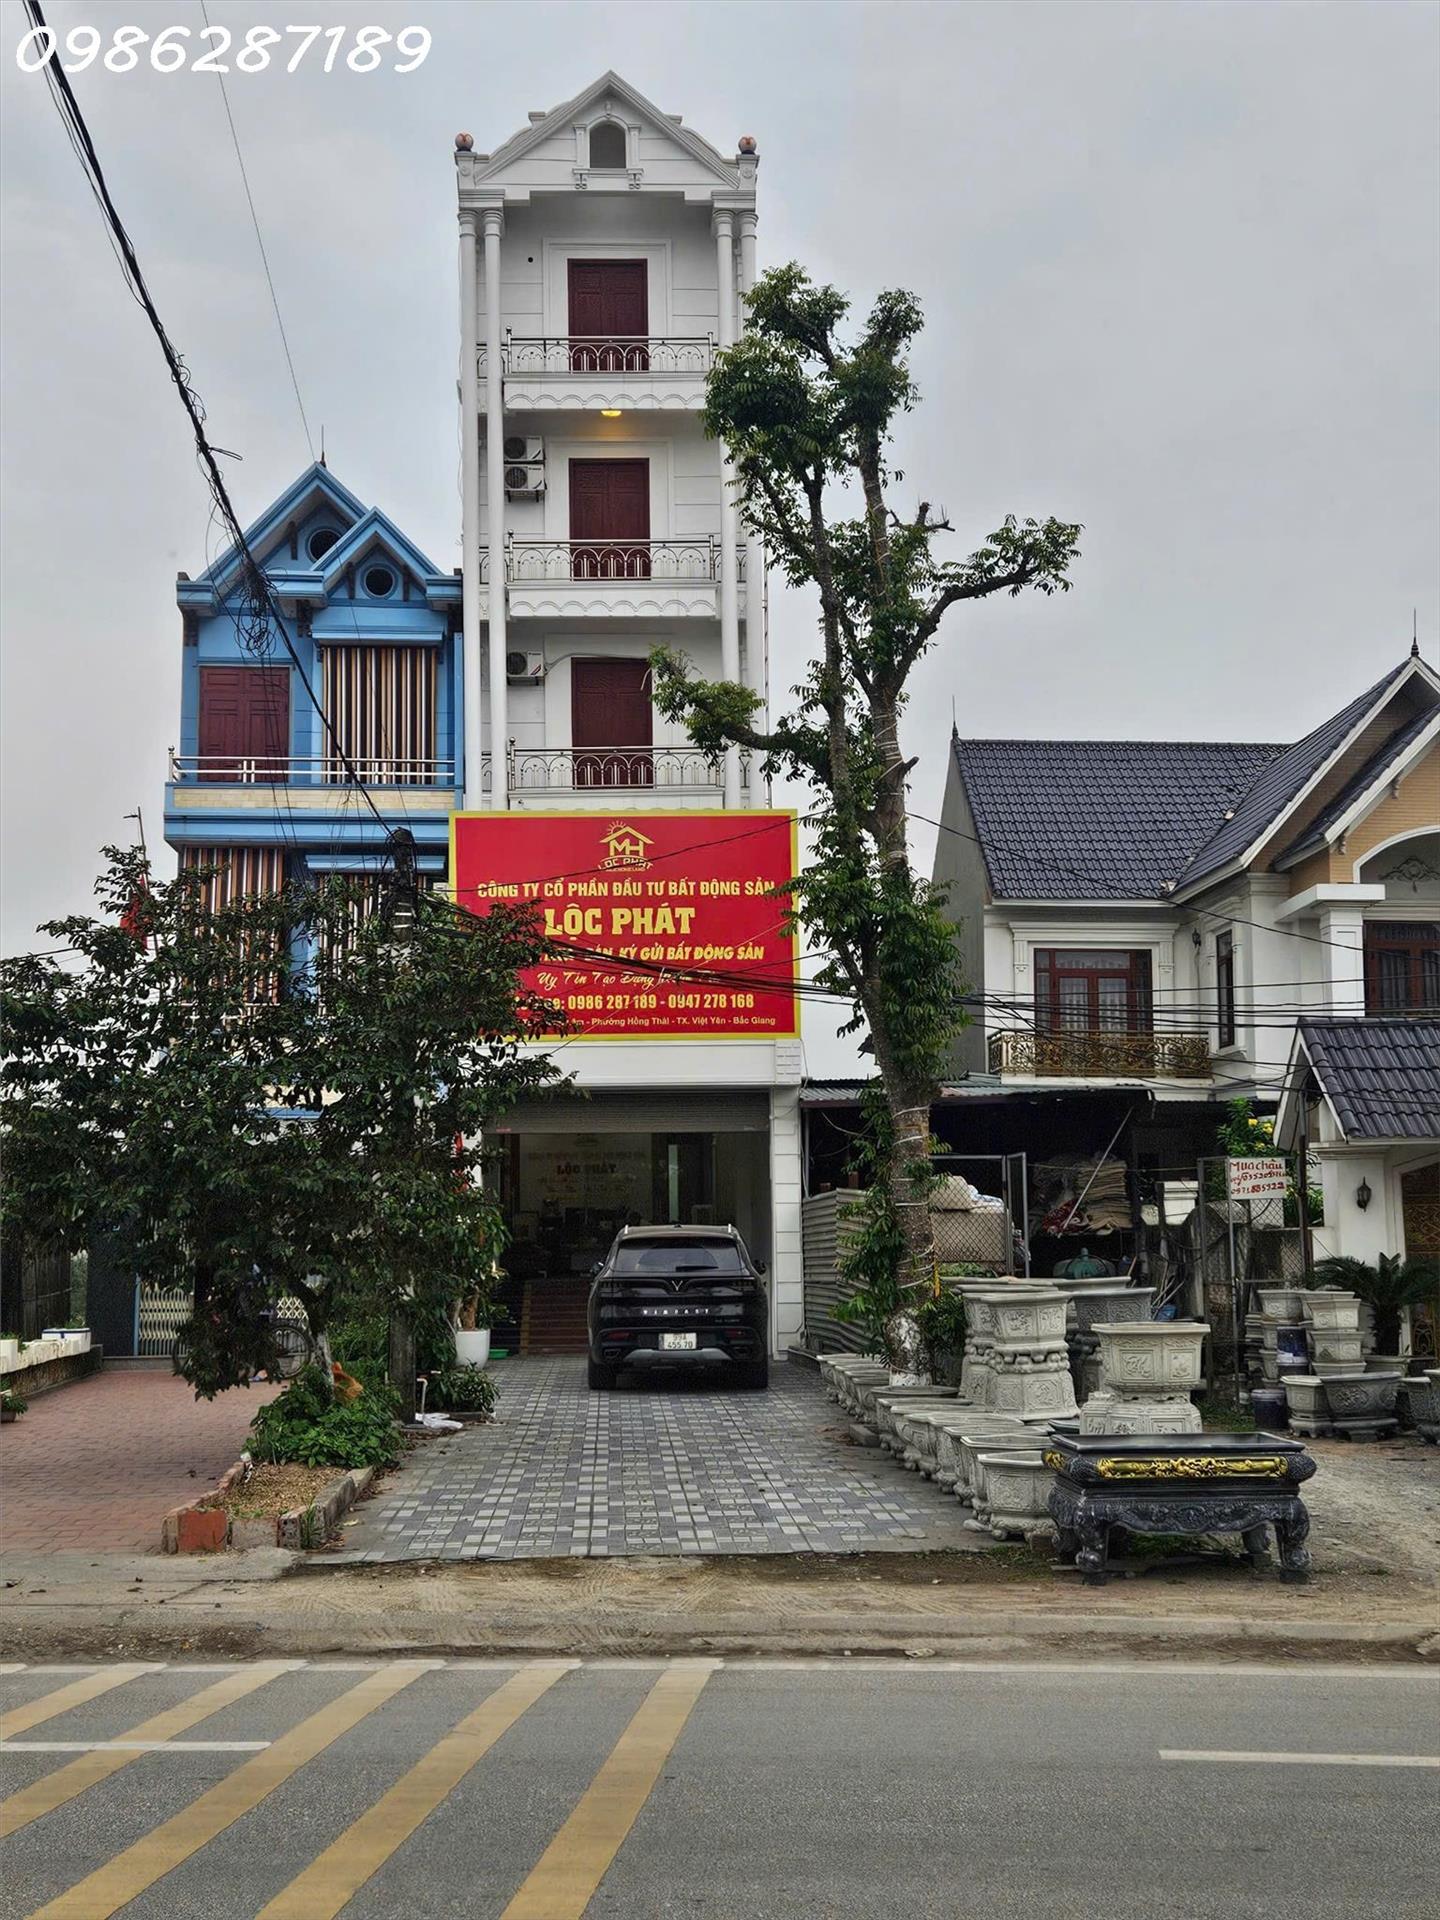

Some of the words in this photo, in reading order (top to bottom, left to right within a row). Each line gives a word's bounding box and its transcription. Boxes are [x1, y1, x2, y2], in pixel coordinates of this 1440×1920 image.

[477, 880, 518, 898] CÔNG
[522, 882, 540, 897] TY
[543, 877, 564, 897] CỔ
[567, 877, 609, 897] PHẦN
[612, 877, 642, 897] ĐẦU
[646, 880, 665, 896] TƯ
[668, 876, 696, 896] BẤT
[700, 878, 741, 899] ĐỘNG
[744, 876, 775, 896] SẢN
[544, 902, 602, 940] LỘC
[611, 902, 696, 935] PHÁT
[640, 942, 664, 960] GỬI
[667, 941, 692, 960] BẤT
[737, 942, 764, 960] SẢN
[568, 995, 603, 1010] 0986
[607, 995, 630, 1009] 287
[633, 994, 657, 1009] 189
[668, 994, 701, 1009] 0947
[703, 994, 727, 1009] 278
[730, 994, 754, 1009] 168
[591, 1018, 626, 1027] Phường
[627, 1016, 650, 1027] Hồng
[692, 1016, 708, 1026] Việt
[710, 1017, 726, 1025] Yên
[733, 1015, 749, 1025] Bắc
[751, 1016, 776, 1026] Giang
